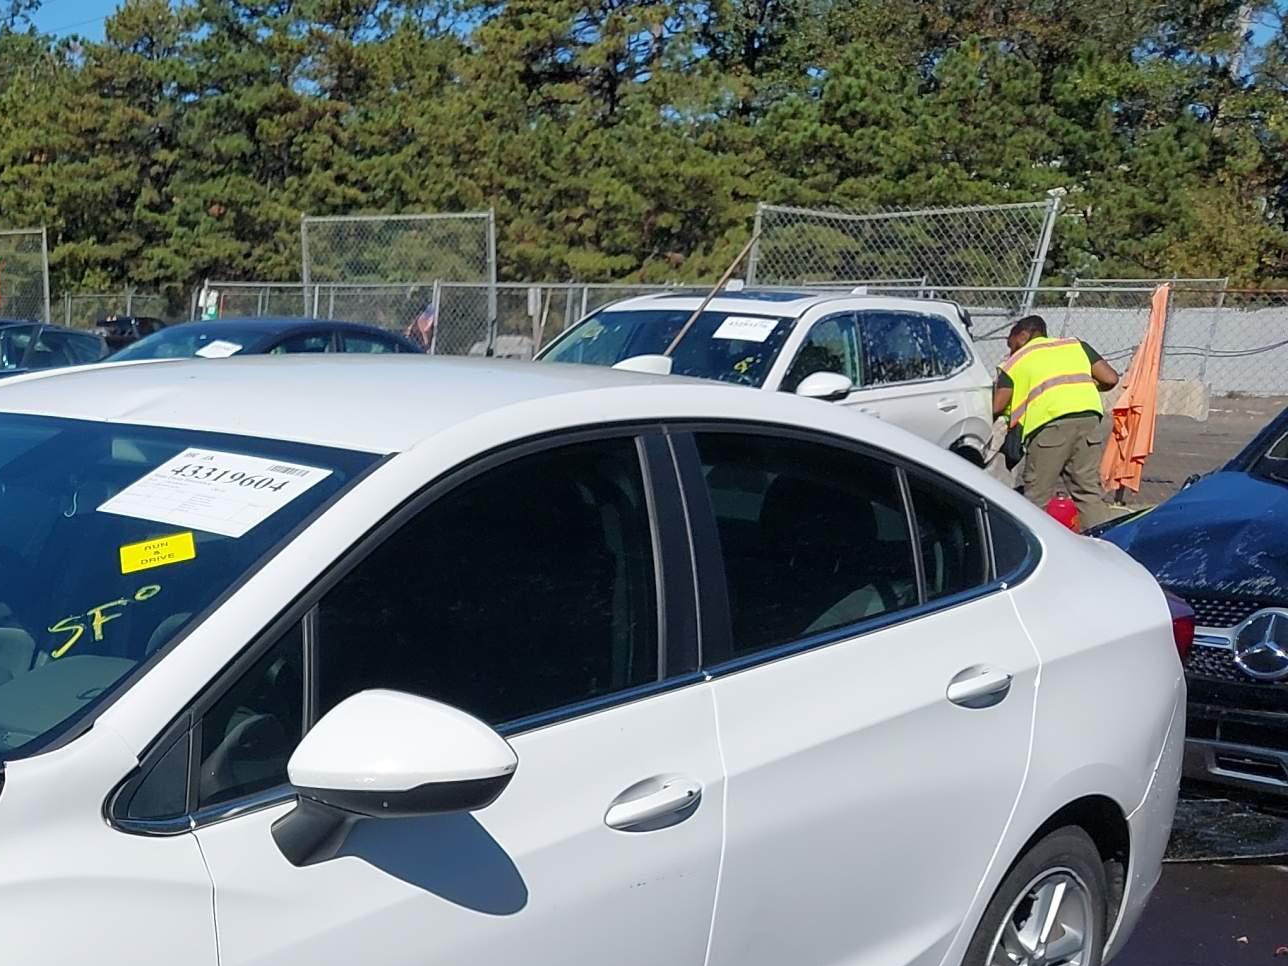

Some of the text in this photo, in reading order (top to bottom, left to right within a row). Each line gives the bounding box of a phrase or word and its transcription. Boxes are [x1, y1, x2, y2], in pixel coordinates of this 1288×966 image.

[171, 463, 290, 494] 43319604
[144, 541, 169, 551] RUN
[140, 552, 175, 565] DRIVE
